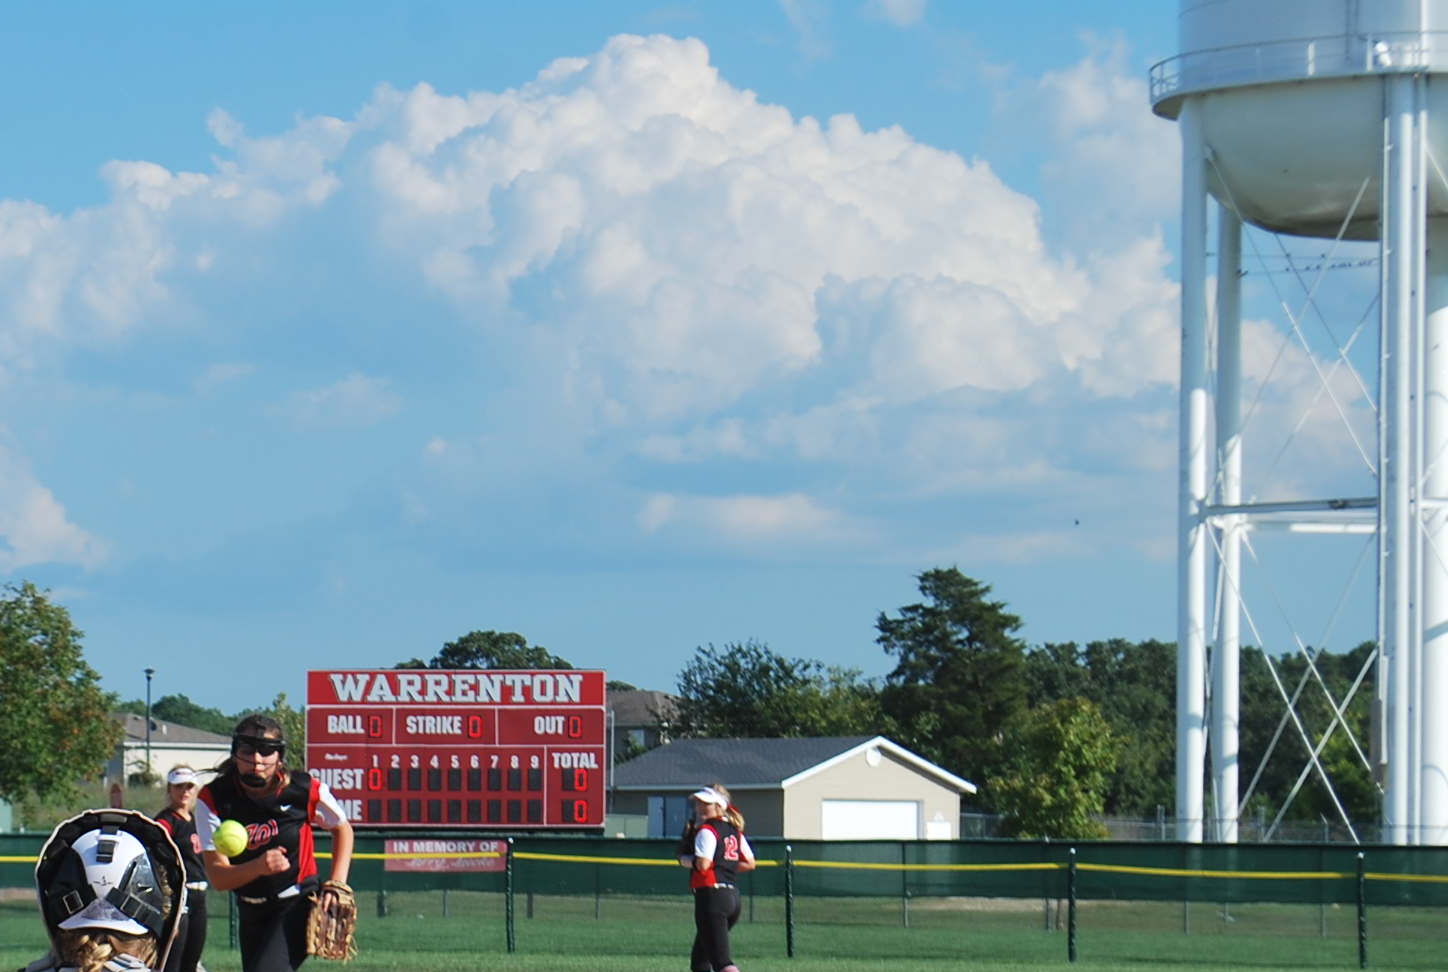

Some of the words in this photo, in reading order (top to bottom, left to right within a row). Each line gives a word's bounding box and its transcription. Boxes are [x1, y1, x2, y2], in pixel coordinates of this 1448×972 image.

[329, 674, 583, 703] WARRENTON
[327, 715, 365, 734] BALL
[369, 715, 382, 737] 0
[406, 716, 462, 734] STRIKE
[469, 716, 482, 738] 0
[534, 716, 565, 734] OUT
[569, 716, 582, 738] 0
[372, 755, 379, 768] 1
[391, 755, 400, 768] 2
[411, 755, 419, 768] 3
[430, 755, 439, 768] 4
[451, 755, 459, 768] 5
[470, 755, 479, 768] 6
[490, 755, 499, 768] 7
[510, 755, 519, 768] 8
[530, 755, 539, 768] 9
[552, 752, 599, 769] TOTAL
[369, 768, 382, 791] 0
[574, 768, 588, 791] 0
[574, 800, 588, 822] 0
[393, 842, 409, 853] IN
[413, 842, 475, 853] MEMORY
[479, 842, 498, 853] OF
[723, 835, 739, 861] 12
